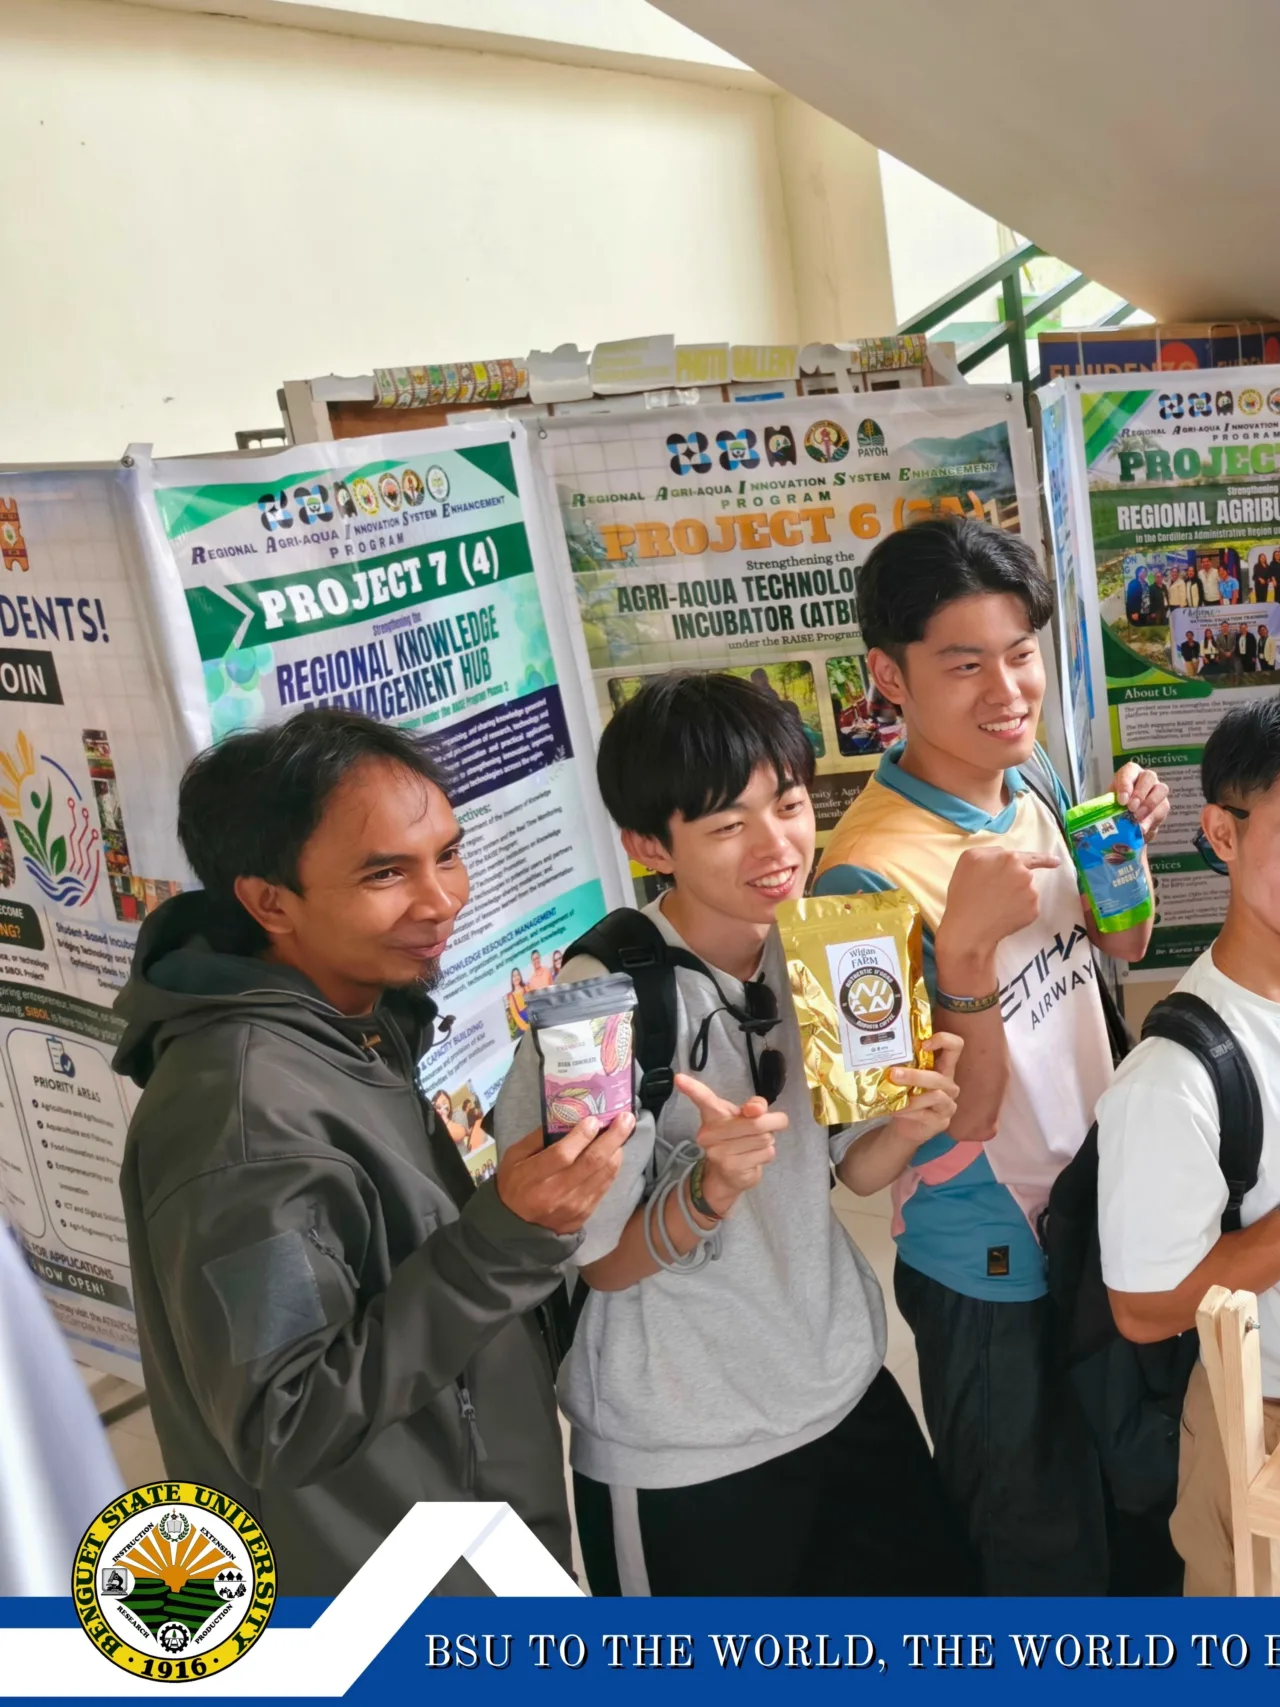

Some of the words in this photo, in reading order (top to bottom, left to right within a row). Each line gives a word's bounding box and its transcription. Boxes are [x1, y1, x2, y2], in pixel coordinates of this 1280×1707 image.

[1121, 427, 1166, 437] REGIONAL
[1172, 424, 1221, 436] AGRI-AQUA
[1223, 421, 1279, 432] INNOVATION
[1212, 431, 1280, 441] PROGRAM
[857, 447, 889, 458] PAYOH
[571, 492, 645, 508] REGIONAL
[655, 485, 732, 501] AGRI-AQUA
[738, 476, 826, 495] INNOVATION
[833, 471, 891, 486] SYSTEM
[899, 462, 999, 482] ENHANCEMENT
[1227, 485, 1279, 497] Strengthening
[721, 490, 831, 510] PROGRAM
[1117, 501, 1211, 531] REGIONAL
[191, 543, 257, 564] REGIONAL
[266, 530, 339, 554] AGRI-AQUA
[344, 517, 400, 541] INNOVATION
[402, 508, 438, 527] SYSTEM
[442, 495, 506, 518] ENHANCEMENT
[600, 507, 835, 561] PROJECT
[849, 503, 881, 540] 6
[1136, 534, 1143, 543] in
[1144, 533, 1156, 543] the
[1157, 531, 1193, 543] Cordillera
[1194, 528, 1246, 540] Administrative
[1247, 526, 1272, 538] Region
[330, 532, 404, 559] PROGRAM
[746, 552, 833, 571] Strengthening
[835, 551, 855, 562] the
[258, 556, 422, 630] PROJECT
[428, 551, 447, 586] 7
[459, 535, 500, 587] (4)
[618, 578, 737, 613] AGRI-AQUA
[372, 614, 412, 637] Strengthening
[413, 612, 422, 626] the
[672, 604, 795, 640] INCUBATOR
[728, 638, 760, 650] under
[762, 637, 779, 648] the
[782, 633, 814, 645] RAISE
[817, 630, 862, 645] Program
[276, 639, 394, 706] REGIONAL
[396, 604, 500, 674] KNOWLEDGE
[460, 646, 492, 690] HUB
[1124, 688, 1160, 699] About
[1163, 686, 1177, 697] Us
[1130, 753, 1188, 767] Objectives
[528, 789, 551, 803] Knowledge
[526, 818, 537, 826] Time
[537, 806, 562, 821] Monitoring
[1118, 864, 1134, 876] MILK
[55, 922, 108, 943] Student-Based
[481, 932, 514, 955] RESOURCE
[514, 907, 557, 936] MANAGEMENT
[850, 948, 876, 958] Wigan
[851, 957, 879, 968] FARM
[425, 1042, 454, 1065] CAPACITY
[452, 1021, 484, 1044] BUILDING
[32, 1075, 74, 1094] PRIORITY
[76, 1087, 102, 1101] AREAS
[50, 1250, 114, 1280] APPLICATIONS
[69, 1277, 106, 1296] OPEN!
